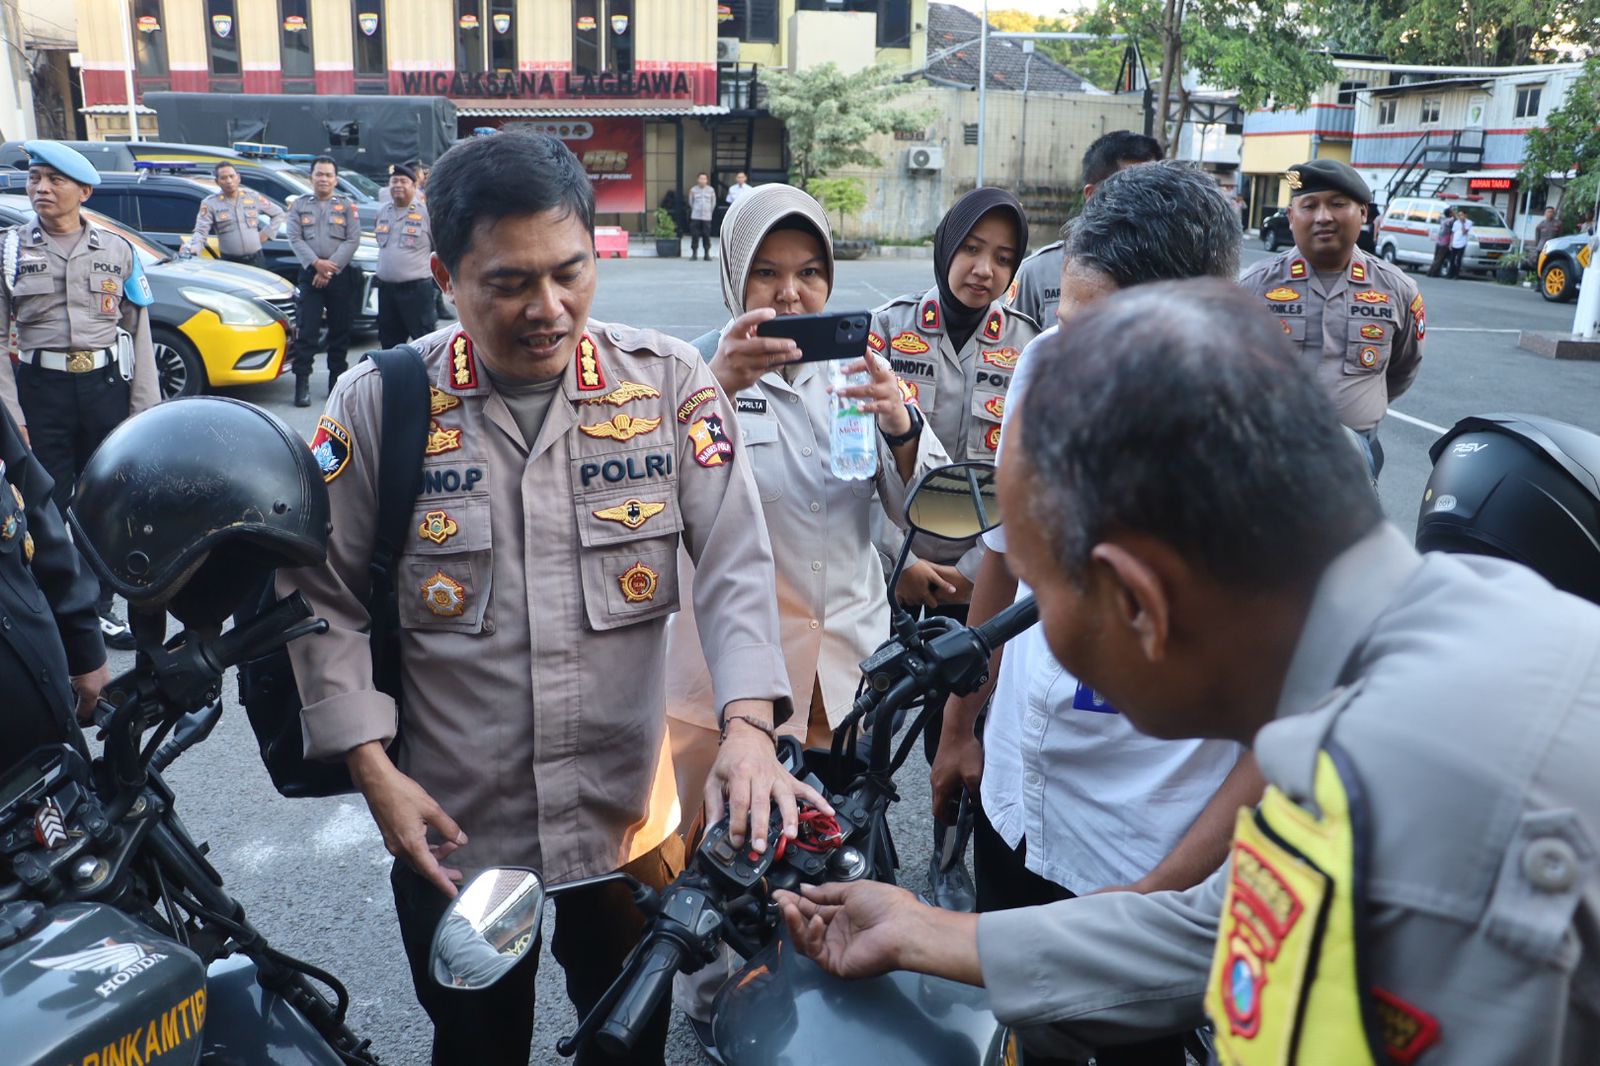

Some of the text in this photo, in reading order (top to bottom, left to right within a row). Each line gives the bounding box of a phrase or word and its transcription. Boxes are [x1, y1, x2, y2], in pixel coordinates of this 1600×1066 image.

[402, 71, 690, 96] WICAKSANA LAGHAWA
[582, 149, 629, 171] PERS
[93, 262, 122, 275] POLRI
[1351, 305, 1393, 318] POLRI
[679, 387, 716, 420] PUSLITBANG
[699, 443, 718, 463] MABES
[1452, 442, 1489, 453] RSV
[581, 454, 673, 486] POLRI
[95, 952, 169, 998] HONDA
